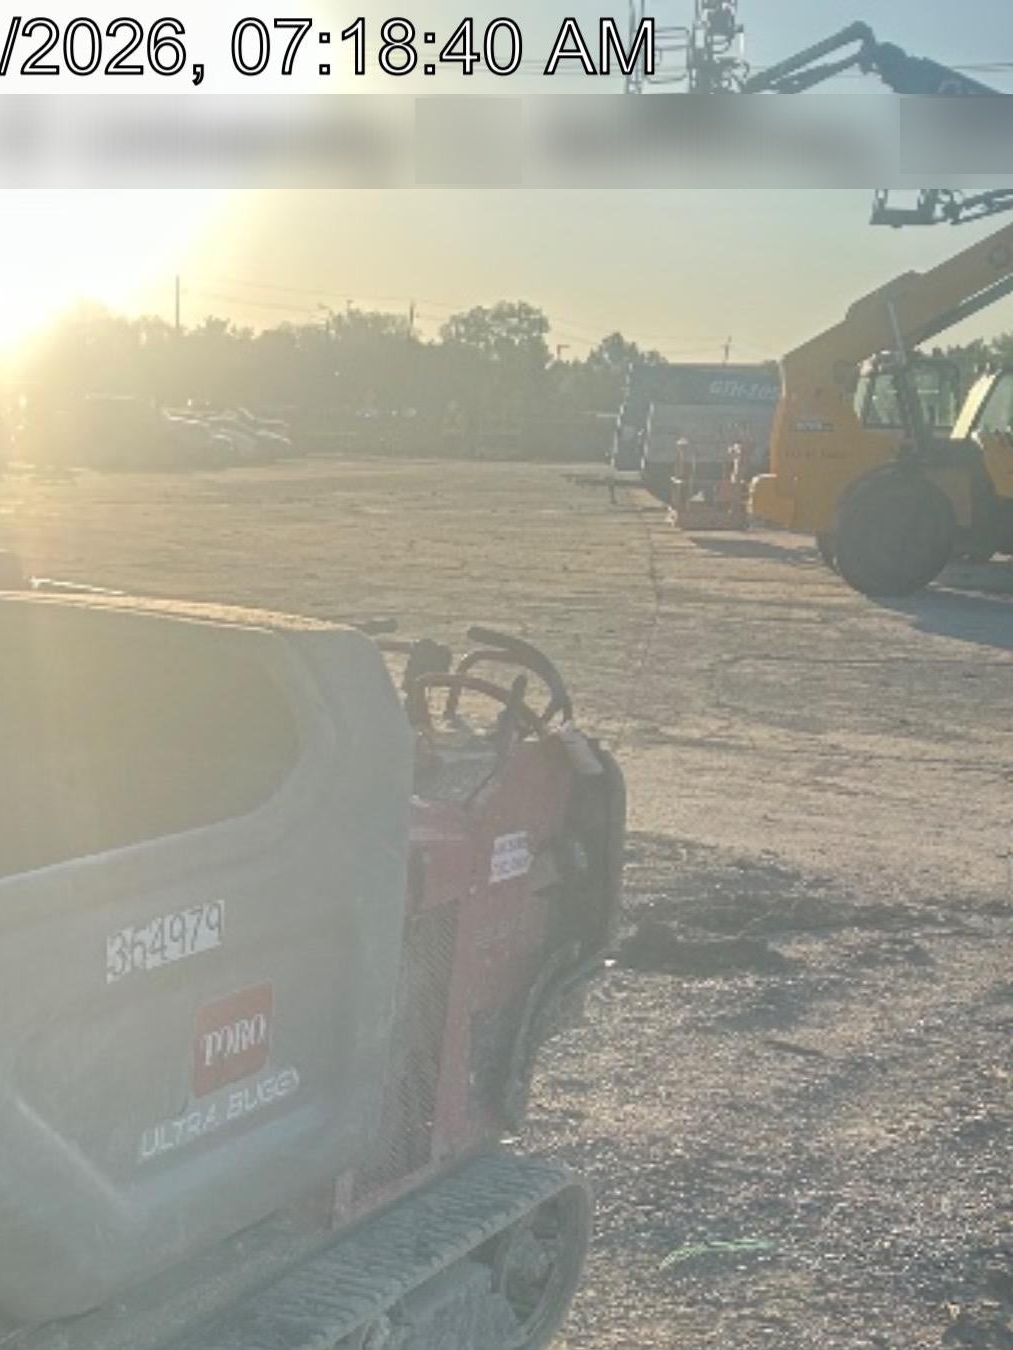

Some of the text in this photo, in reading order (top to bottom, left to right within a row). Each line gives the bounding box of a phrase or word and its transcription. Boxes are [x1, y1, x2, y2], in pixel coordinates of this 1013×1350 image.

[106, 902, 223, 977] 364979
[202, 1012, 267, 1067] TORO
[139, 1103, 220, 1158] ULTRA
